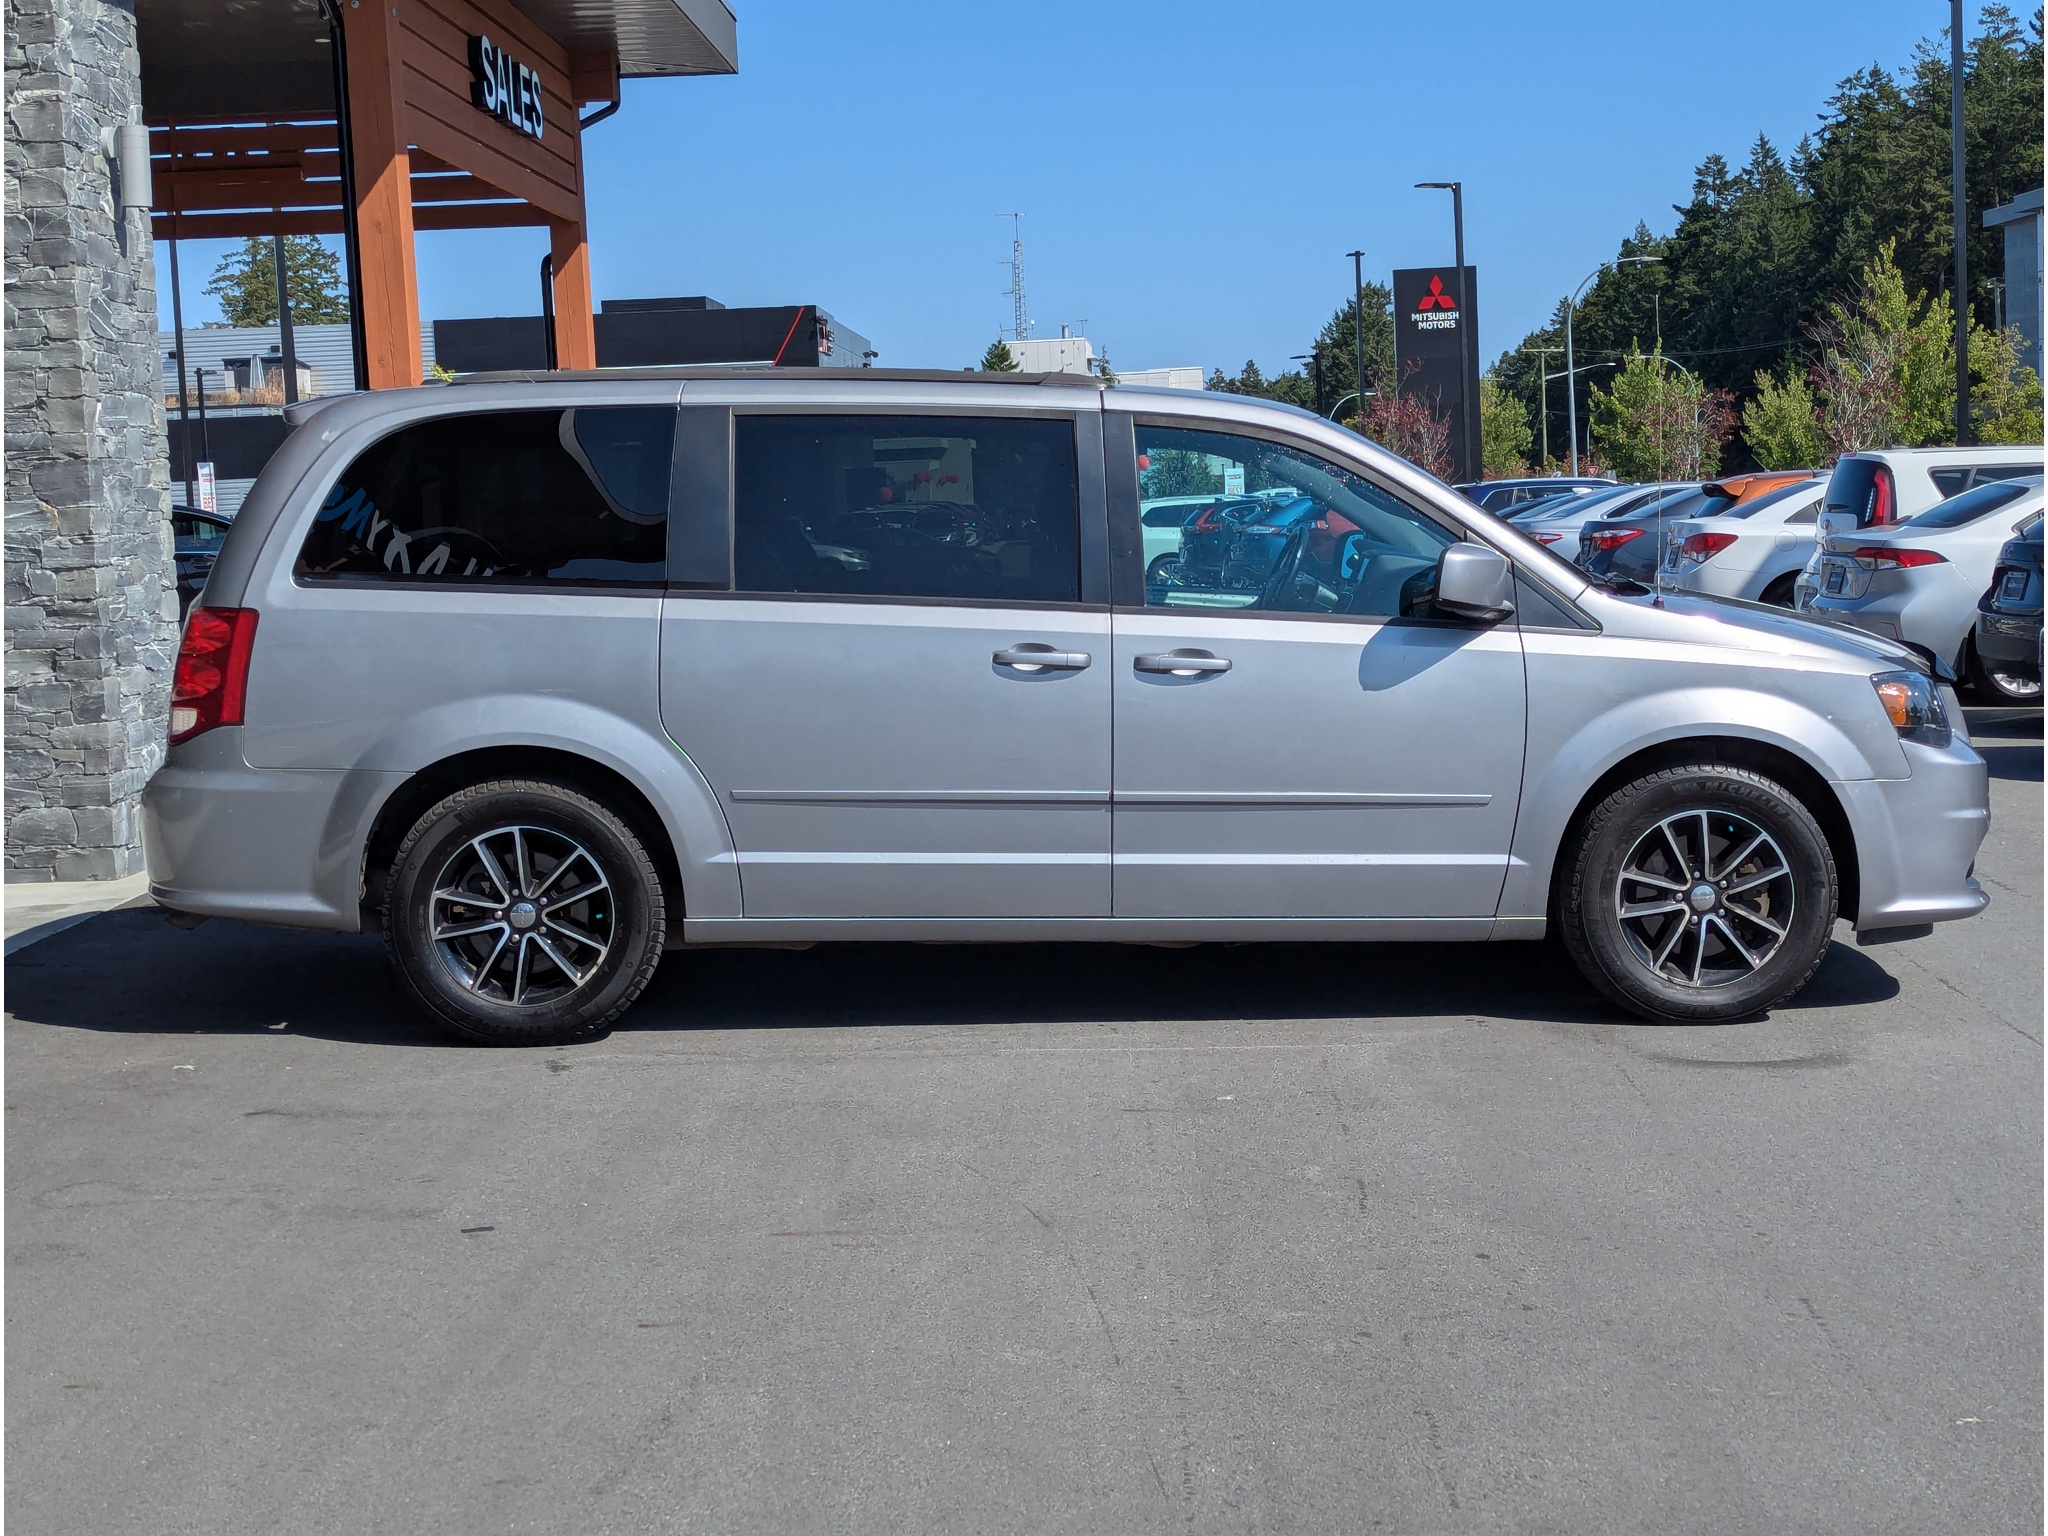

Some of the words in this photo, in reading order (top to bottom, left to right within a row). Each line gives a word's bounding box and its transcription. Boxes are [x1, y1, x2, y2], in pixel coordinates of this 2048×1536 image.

[481, 34, 544, 140] SALES
[1411, 311, 1460, 322] MITSUBISH
[1418, 320, 1456, 330] MOTORS
